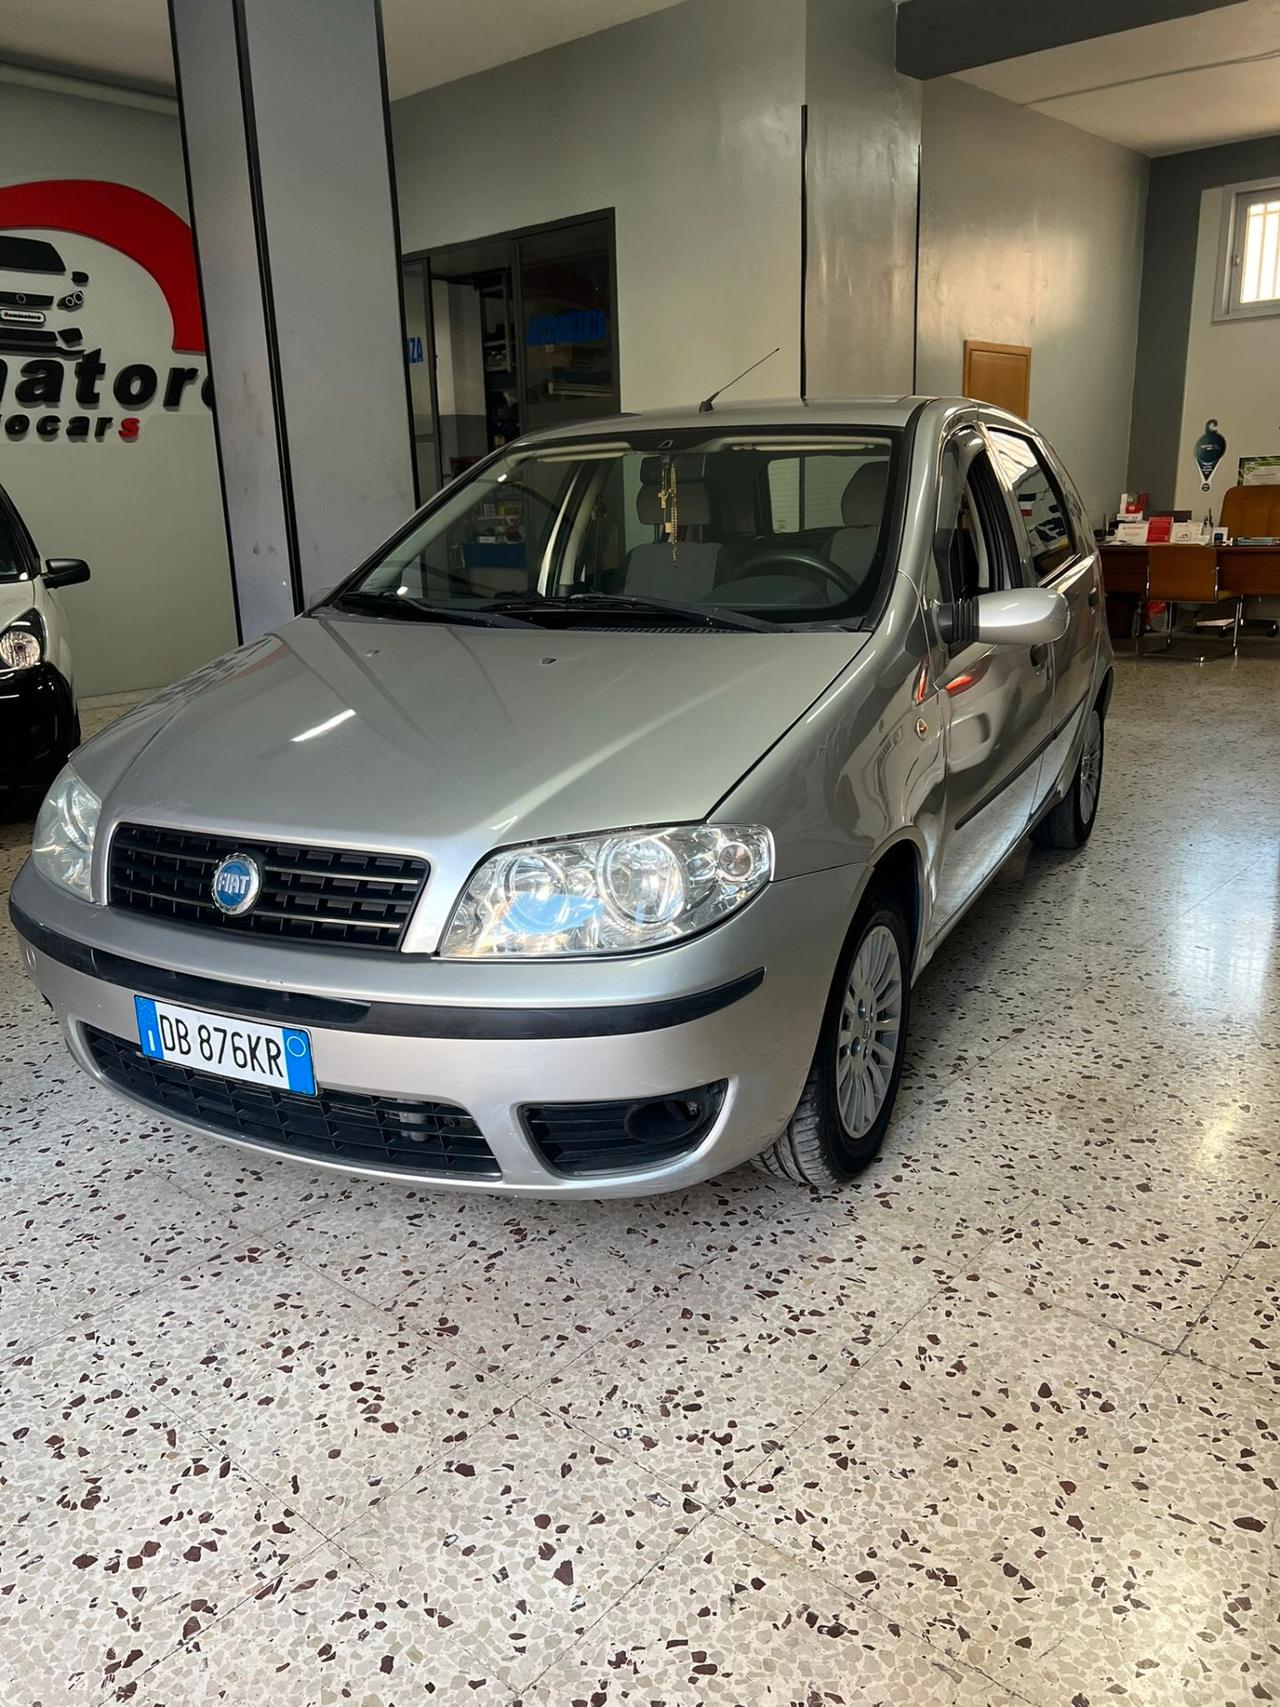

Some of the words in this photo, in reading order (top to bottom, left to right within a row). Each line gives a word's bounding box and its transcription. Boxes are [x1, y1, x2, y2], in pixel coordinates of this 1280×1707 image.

[0, 348, 214, 408] ator
[0, 414, 140, 439] ocars
[217, 872, 250, 894] FIAT
[159, 1014, 191, 1055] DB
[197, 1024, 284, 1077] 876KR
